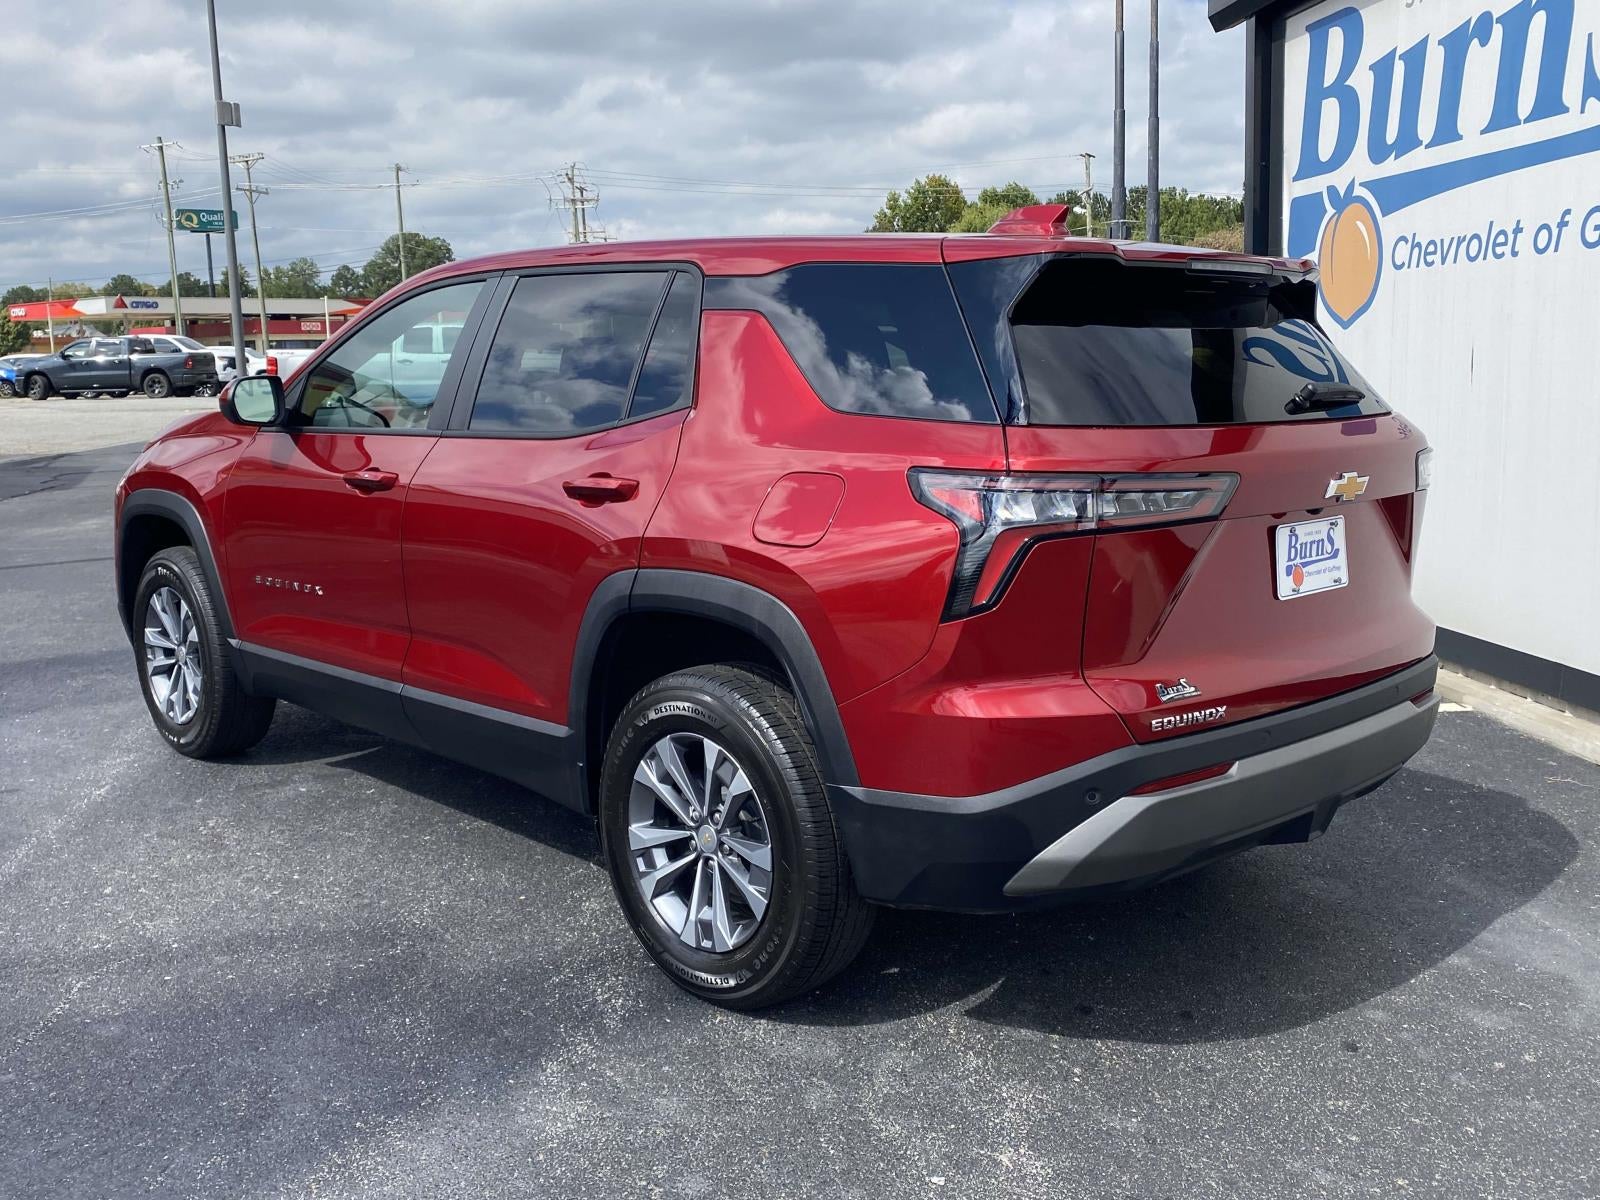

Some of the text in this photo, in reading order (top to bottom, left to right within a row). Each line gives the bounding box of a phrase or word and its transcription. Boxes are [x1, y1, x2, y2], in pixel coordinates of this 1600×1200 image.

[200, 212, 224, 223] Quali
[1391, 217, 1524, 271] Chevrolet
[1533, 208, 1572, 255] of
[131, 301, 159, 309] CITGO
[255, 575, 324, 597] EQUINOX
[654, 704, 706, 719] DESTINATION
[1151, 705, 1227, 732] EQUINOX
[674, 965, 729, 986] DESTINATION
